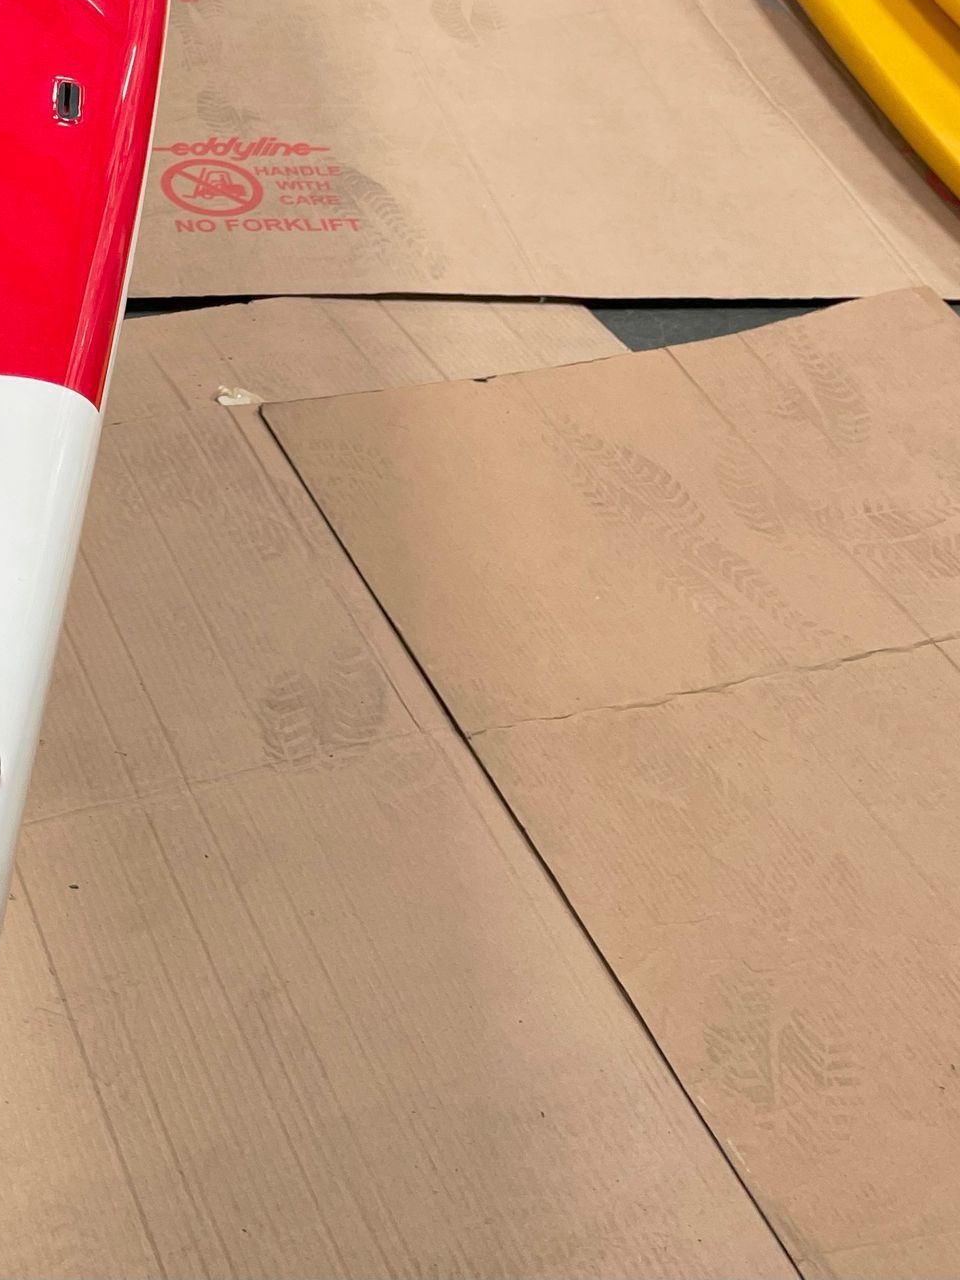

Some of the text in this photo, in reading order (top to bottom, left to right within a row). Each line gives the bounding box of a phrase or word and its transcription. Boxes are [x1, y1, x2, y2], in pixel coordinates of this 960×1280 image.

[153, 136, 330, 161] eddyline
[254, 166, 341, 177] HANDLE
[276, 180, 331, 191] WITH
[279, 195, 339, 206] CARE
[175, 218, 359, 233] NO FORKLIFT
